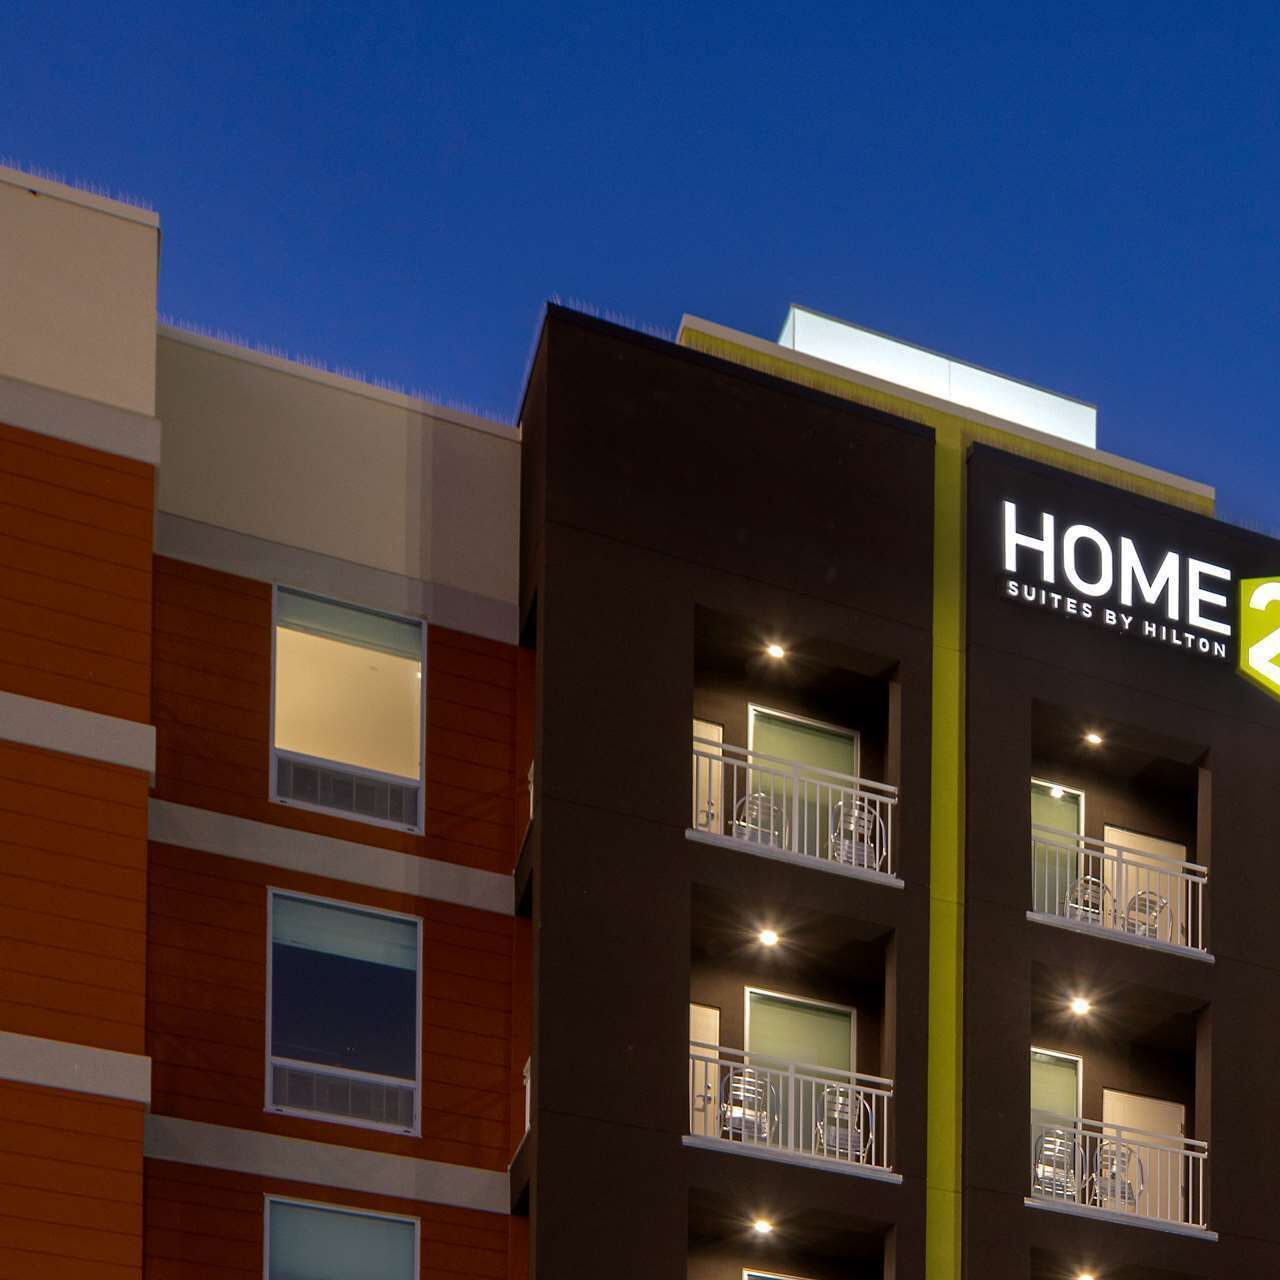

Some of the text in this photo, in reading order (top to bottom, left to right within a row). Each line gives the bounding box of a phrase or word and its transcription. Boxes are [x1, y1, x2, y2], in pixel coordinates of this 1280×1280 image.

[1004, 500, 1231, 636] HOME
[1007, 581, 1226, 658] SUITES BY HILTON
